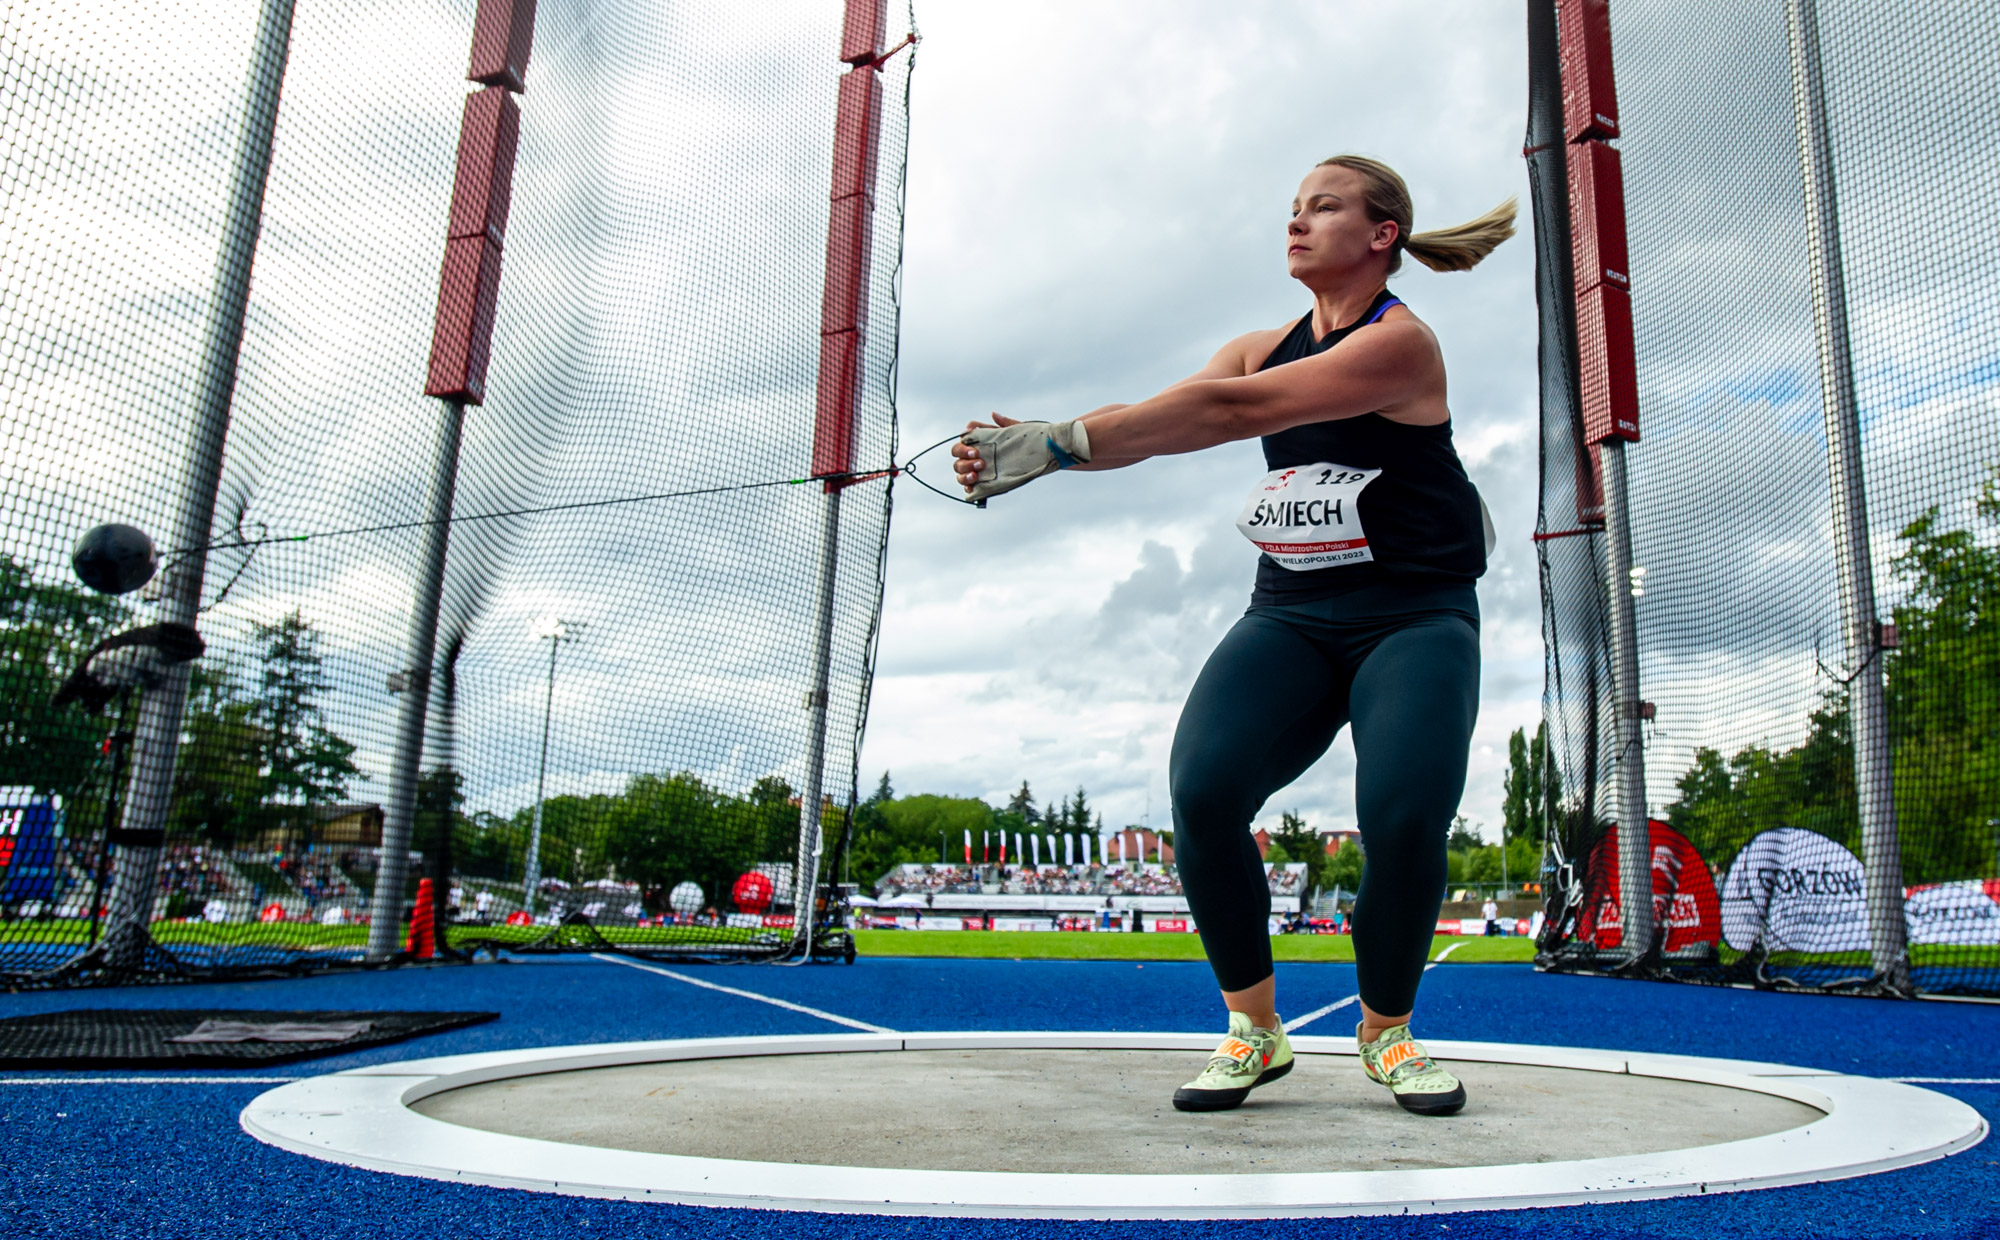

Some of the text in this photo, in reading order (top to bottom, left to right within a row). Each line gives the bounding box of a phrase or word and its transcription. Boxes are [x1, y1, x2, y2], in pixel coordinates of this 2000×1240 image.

[1316, 468, 1365, 485] 119
[1248, 498, 1343, 527] ŚMIECH
[1325, 542, 1349, 550] Polski
[1281, 555, 1341, 564] WIELKOPOLSKI
[1343, 551, 1364, 559] 2023
[1758, 862, 1861, 894] GORZÓW
[1159, 921, 1184, 930] PZLA
[1382, 1042, 1419, 1073] NIKE
